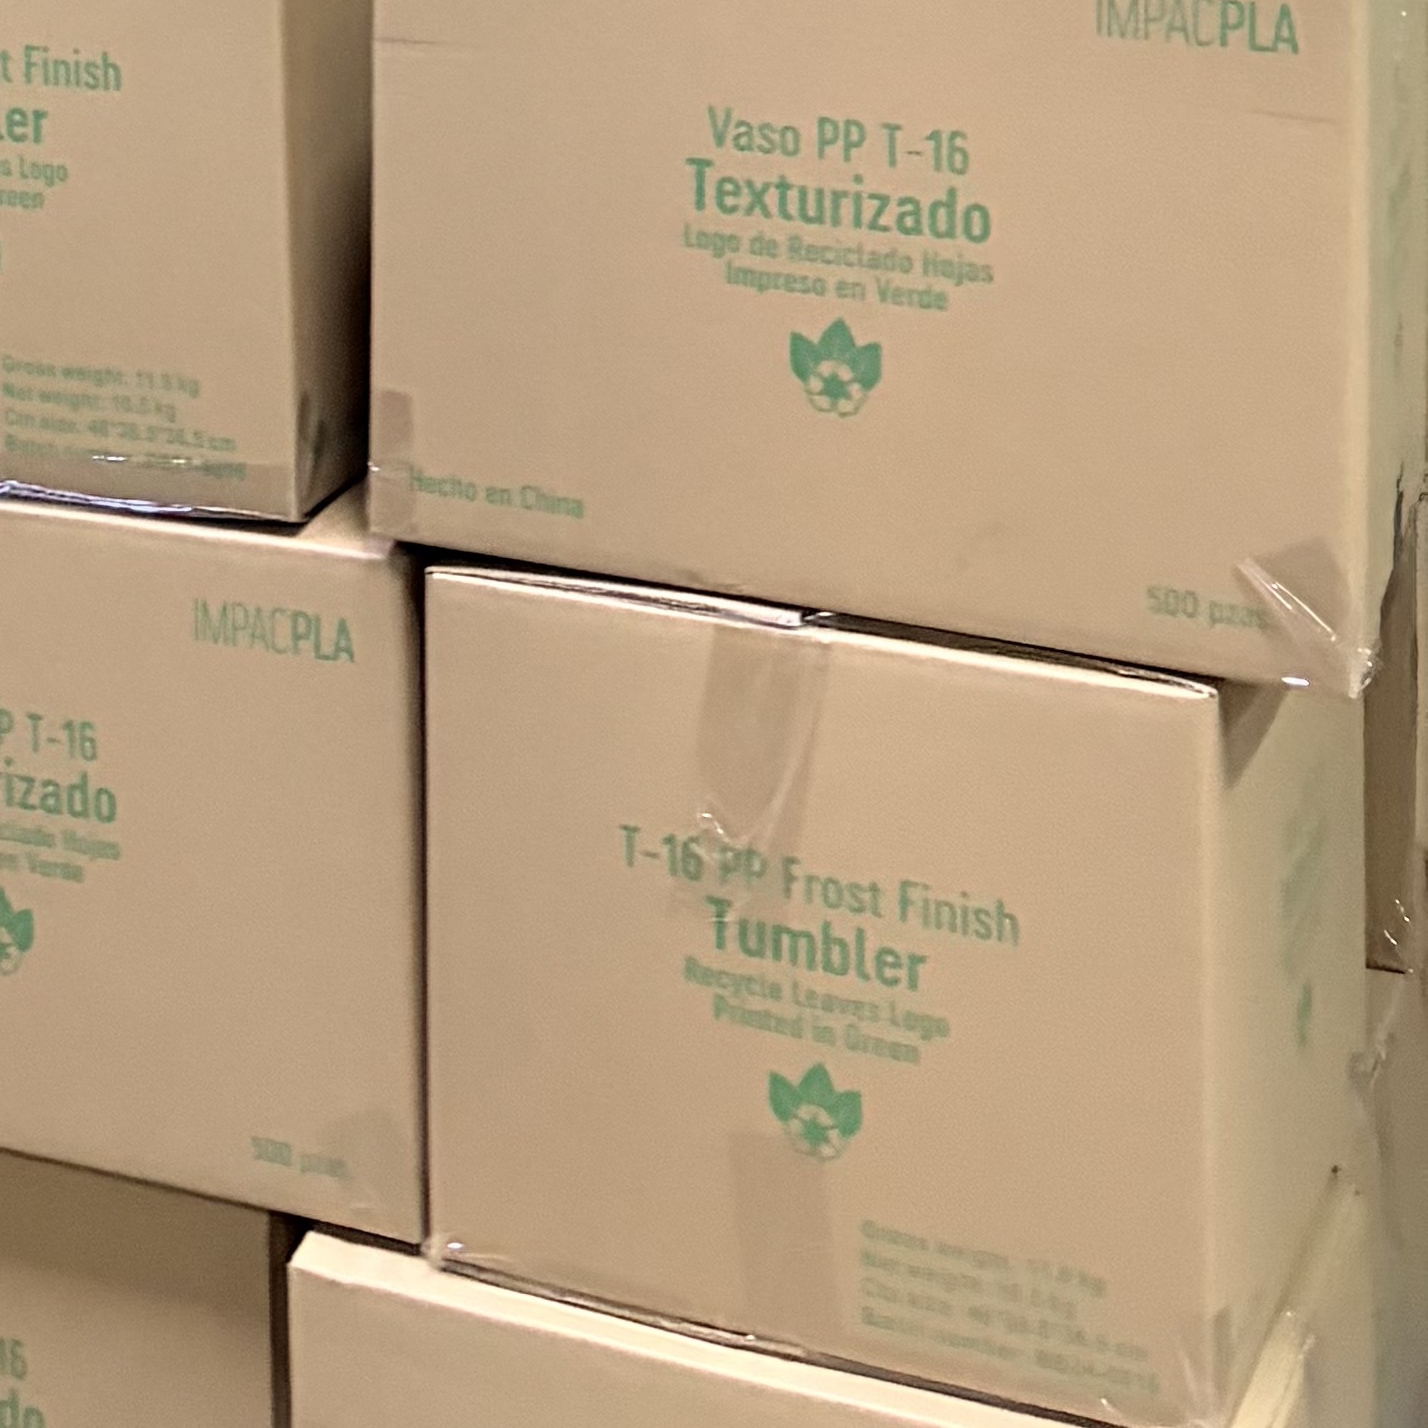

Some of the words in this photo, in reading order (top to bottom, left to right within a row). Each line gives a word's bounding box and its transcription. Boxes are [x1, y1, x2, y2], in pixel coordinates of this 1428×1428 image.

[22, 44, 122, 92] Finish
[18, 154, 70, 188] Logo
[707, 104, 802, 159] Vaso
[816, 116, 867, 164] PP
[881, 121, 970, 177] T-16
[685, 156, 992, 245] Texturizado
[683, 222, 741, 260] Logo
[748, 230, 779, 259] de
[786, 234, 914, 275] Reciclado
[921, 247, 995, 288] Hojas
[725, 259, 828, 297] Impreso
[834, 277, 866, 302] en
[875, 275, 950, 312] Verde
[191, 597, 355, 663] IMPACPLA
[1146, 586, 1199, 620] 500
[25, 711, 98, 762] T-16
[619, 823, 704, 883] T-16
[781, 855, 883, 919] Frost
[897, 878, 1021, 947] Finish
[705, 894, 929, 992] Tumbler
